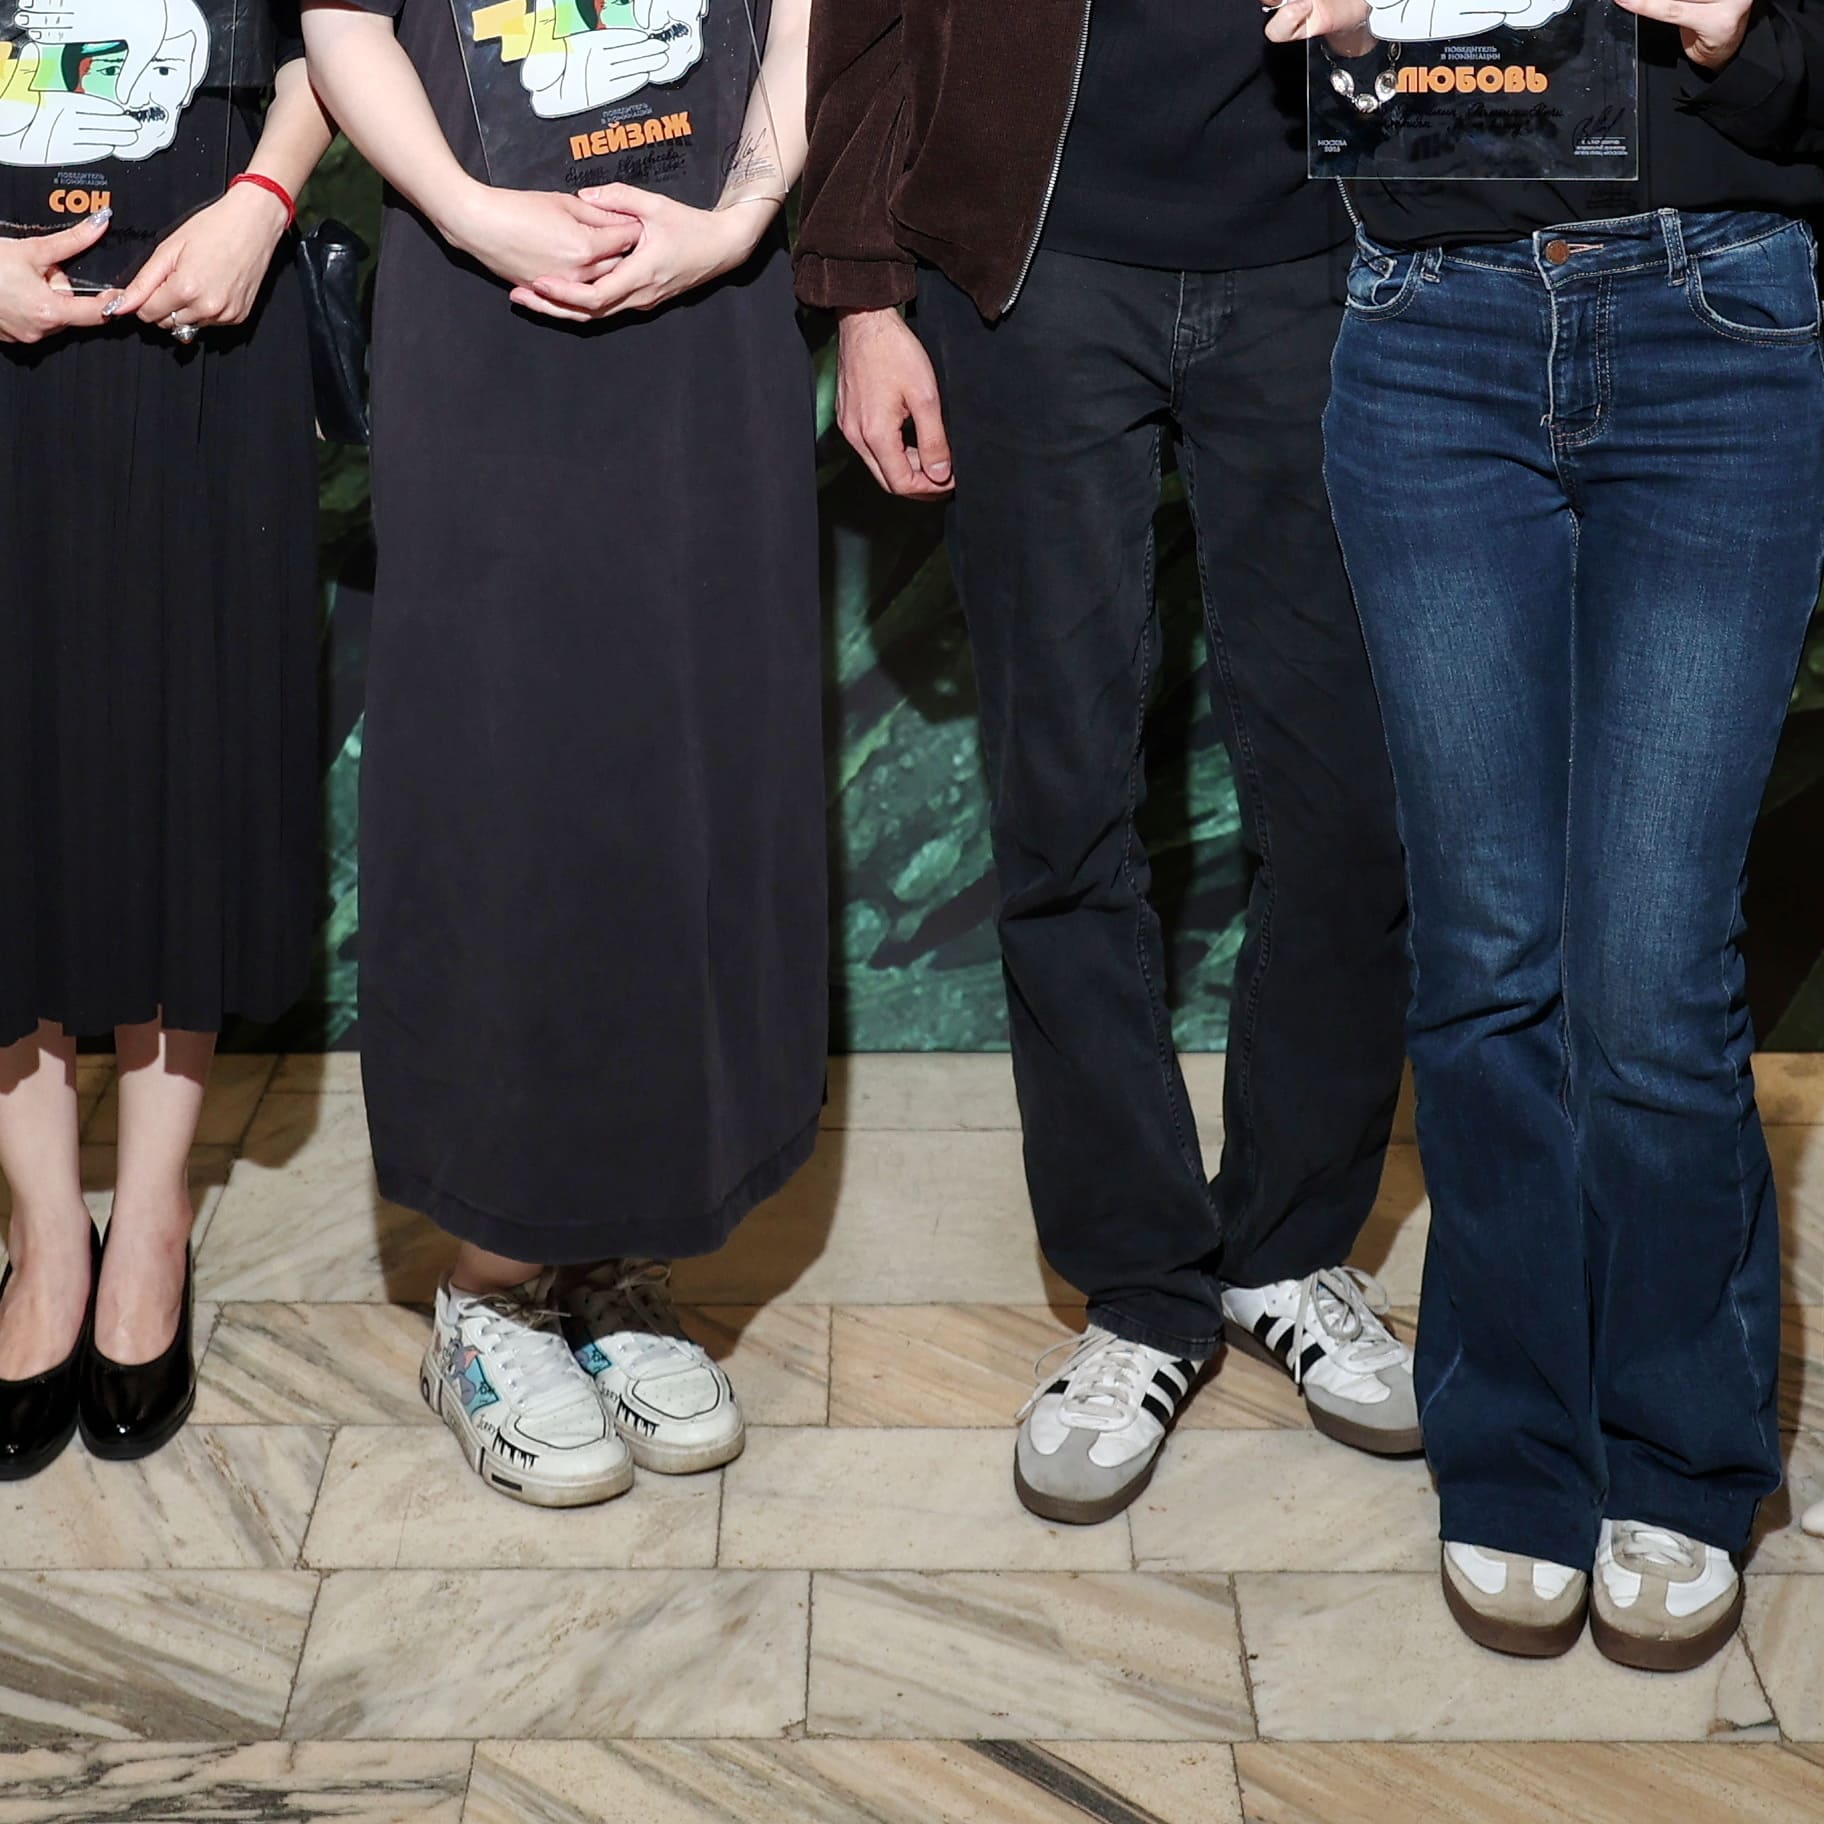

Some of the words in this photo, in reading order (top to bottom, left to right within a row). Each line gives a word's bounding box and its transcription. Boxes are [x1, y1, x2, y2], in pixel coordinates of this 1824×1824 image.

[1396, 65, 1549, 94] ЛЮБОВЬ
[570, 111, 692, 160] ПЕЙЗАЖ
[49, 189, 111, 214] СОН
